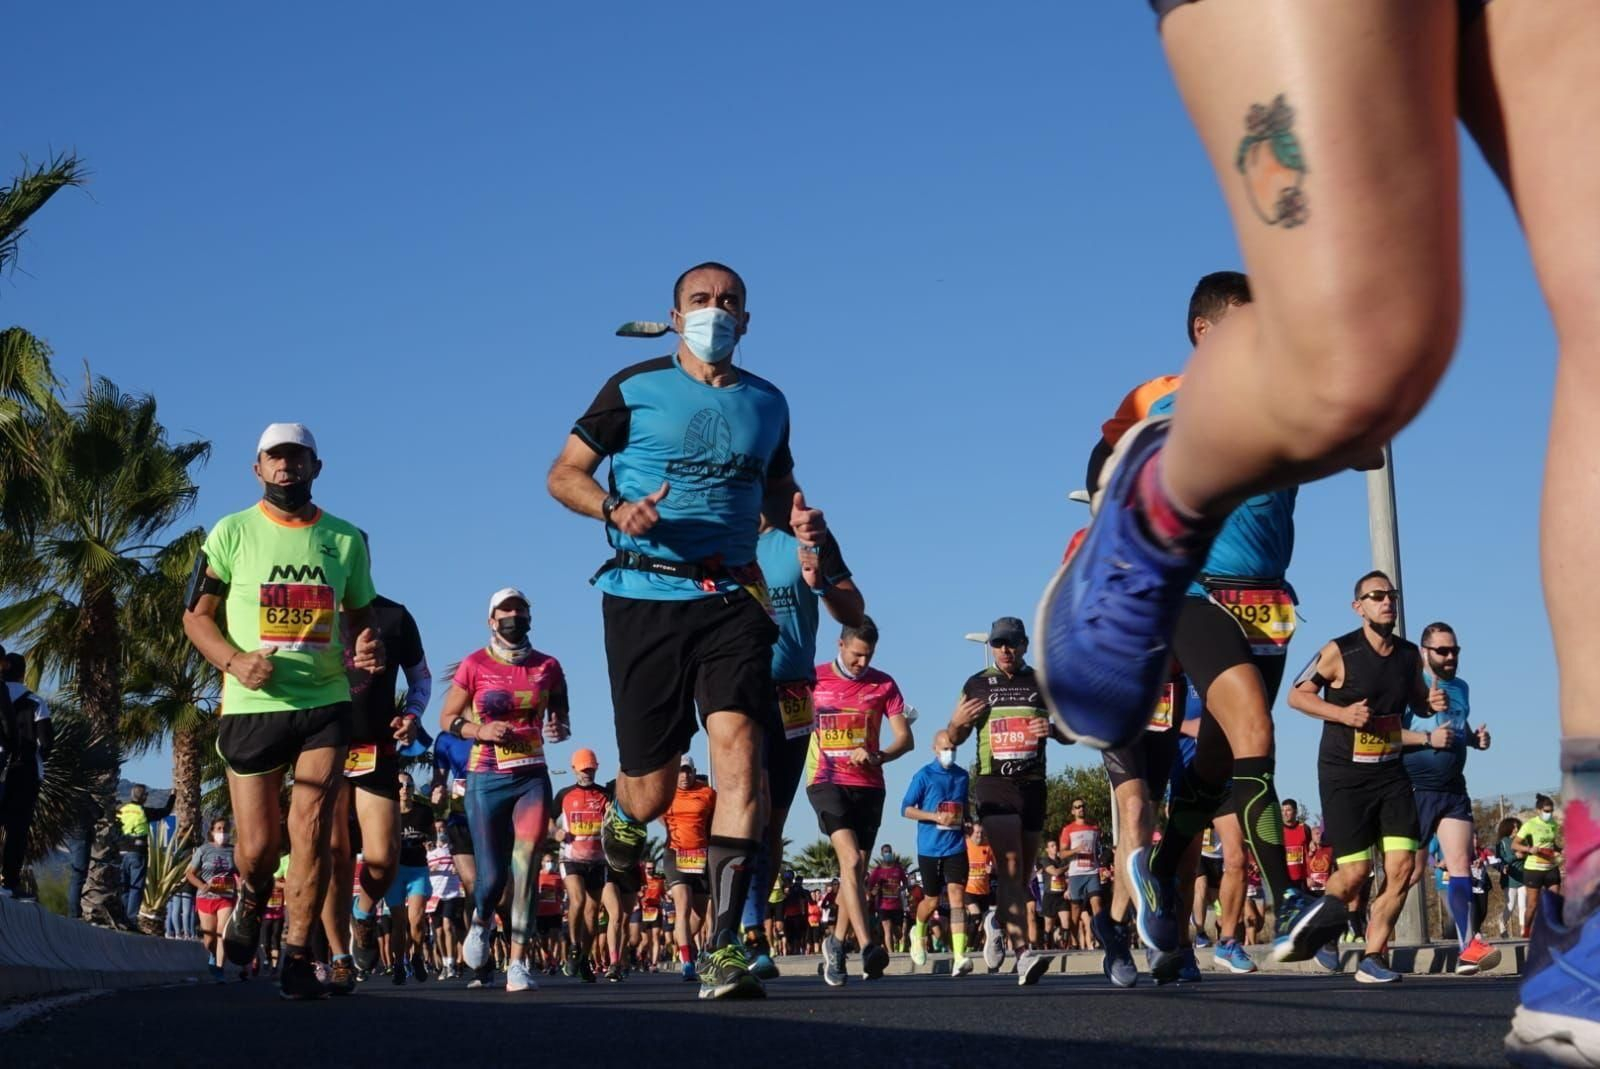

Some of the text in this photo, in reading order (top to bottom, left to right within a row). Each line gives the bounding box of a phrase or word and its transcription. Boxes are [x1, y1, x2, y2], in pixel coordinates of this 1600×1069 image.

[266, 608, 313, 625] 6235
[1229, 604, 1270, 623] 993
[988, 692, 1038, 706] Genal
[825, 728, 854, 741] 6376
[994, 731, 1025, 744] 3789
